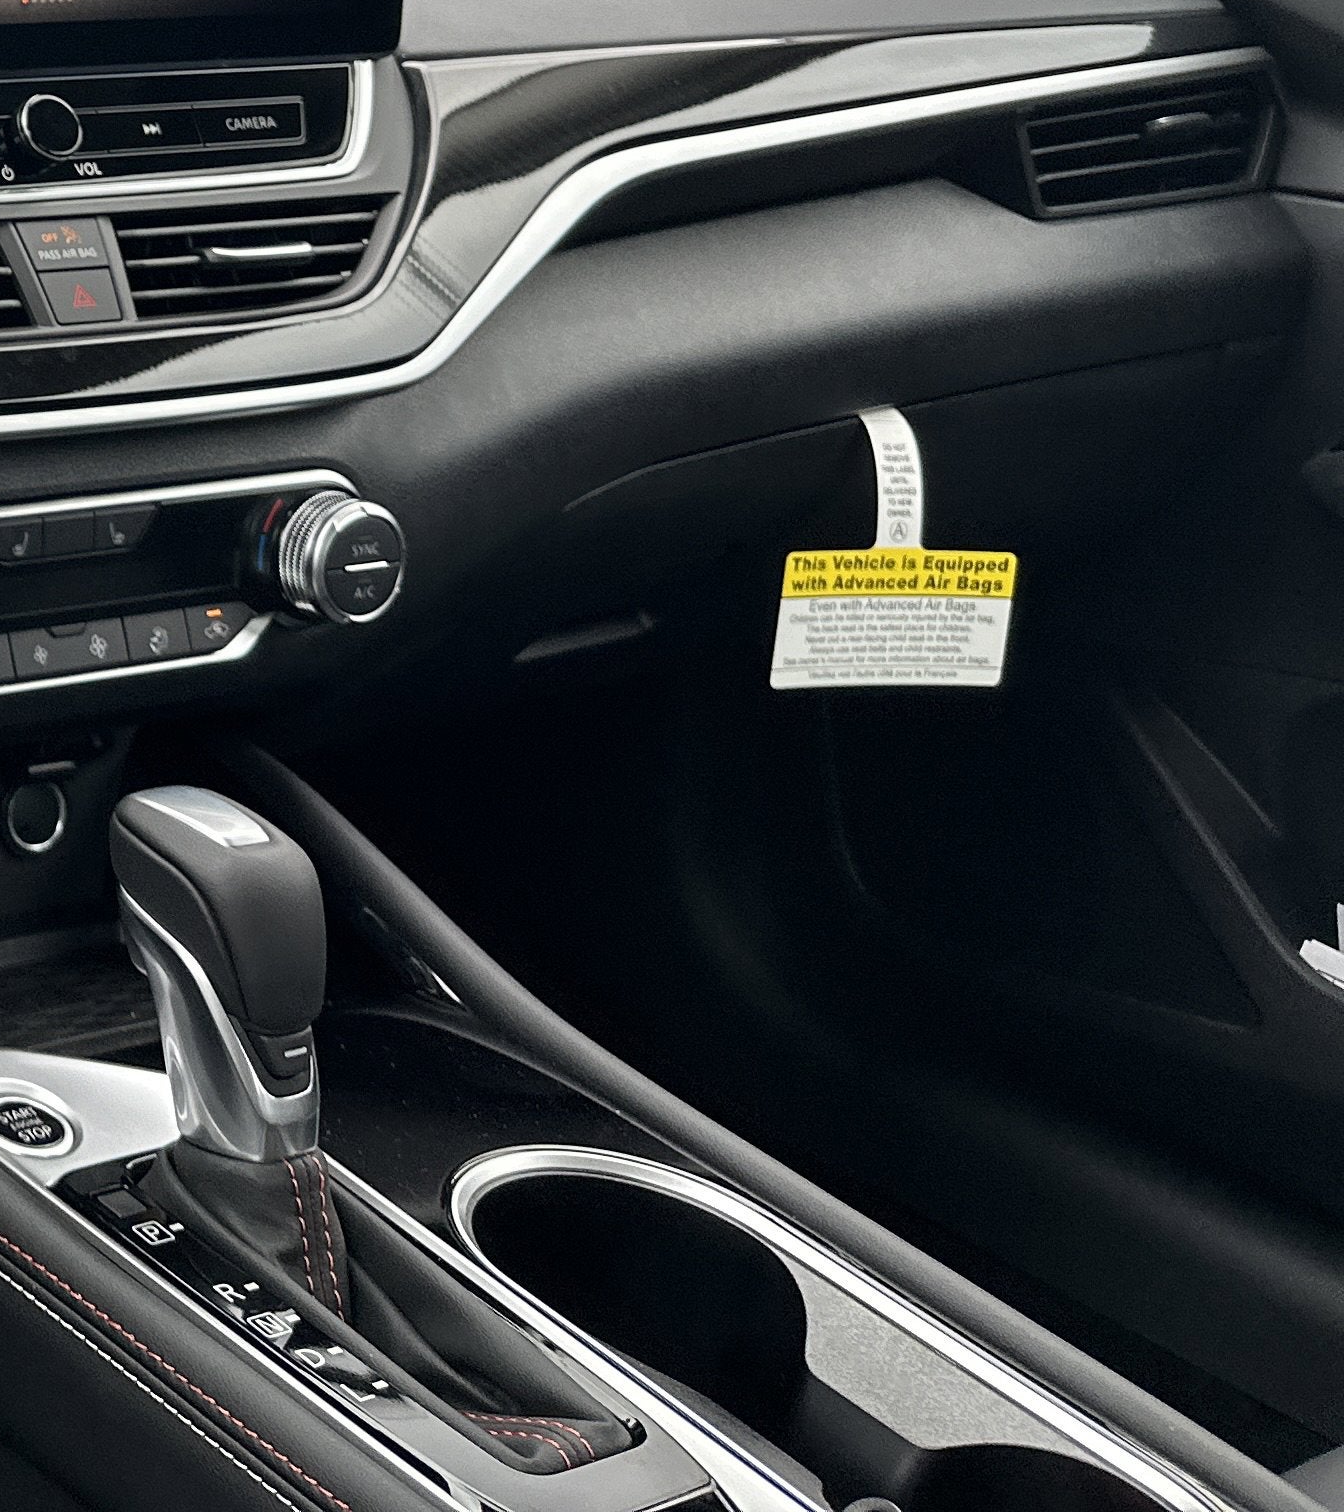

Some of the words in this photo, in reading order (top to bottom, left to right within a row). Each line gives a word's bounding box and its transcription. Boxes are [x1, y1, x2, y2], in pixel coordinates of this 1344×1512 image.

[224, 115, 280, 132] CAMERA
[73, 161, 104, 177] VOL
[40, 231, 59, 244] OFF
[37, 248, 62, 261] PASS
[62, 247, 79, 259] AIR
[791, 555, 827, 572] This
[832, 555, 897, 571] Vehicle
[901, 555, 917, 570] is
[922, 555, 1010, 575] Equipped
[354, 584, 376, 600] A/C
[791, 574, 828, 592] with
[832, 573, 919, 591] Advanced
[924, 574, 951, 591] Air
[956, 575, 1004, 594] Bags
[808, 598, 837, 614] Even
[839, 597, 863, 612] with
[864, 597, 923, 612] Advanced
[924, 597, 943, 612] Air
[945, 598, 977, 614] Bags
[17, 1123, 53, 1143] STOP
[141, 1225, 161, 1241] P
[212, 1282, 247, 1304] R
[254, 1315, 285, 1335] N
[294, 1347, 327, 1369] D
[339, 1383, 376, 1403] L
